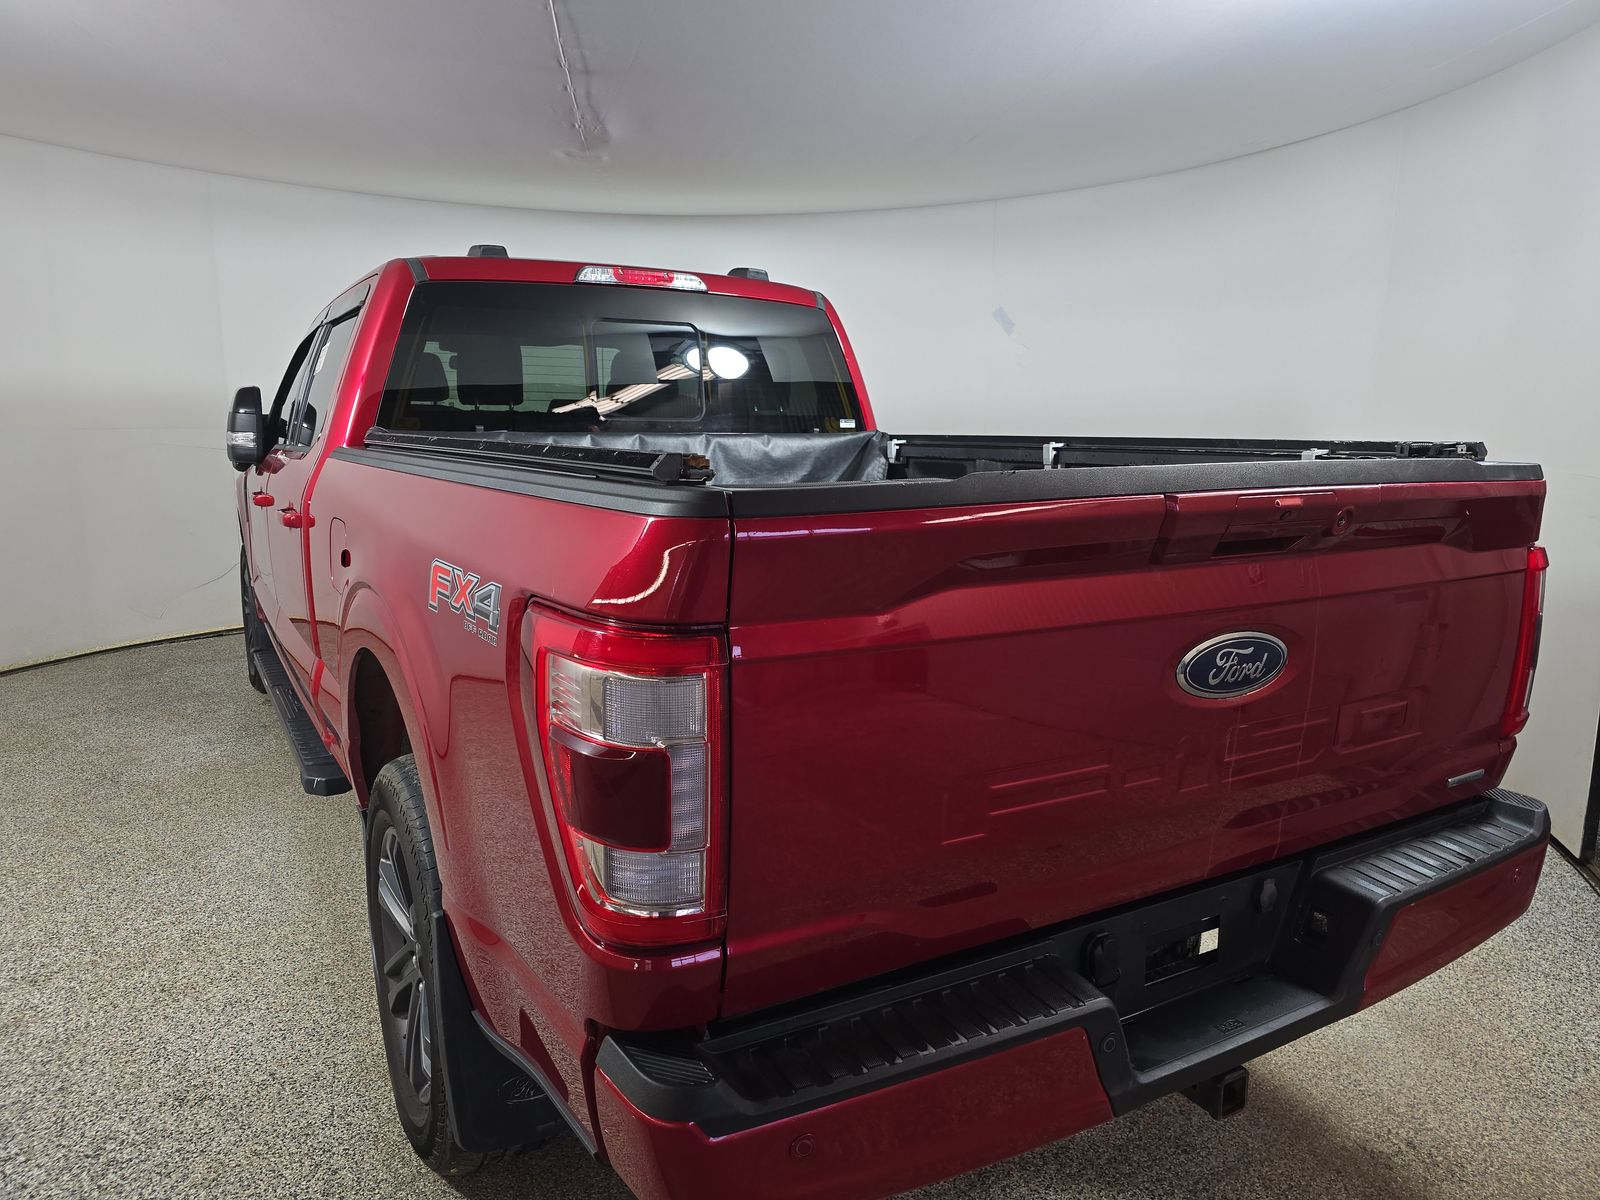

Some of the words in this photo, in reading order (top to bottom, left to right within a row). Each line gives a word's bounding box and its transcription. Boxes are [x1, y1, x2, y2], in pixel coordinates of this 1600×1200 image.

[428, 558, 503, 634] FX4
[478, 627, 498, 647] ROAD
[1208, 647, 1268, 686] Ford
